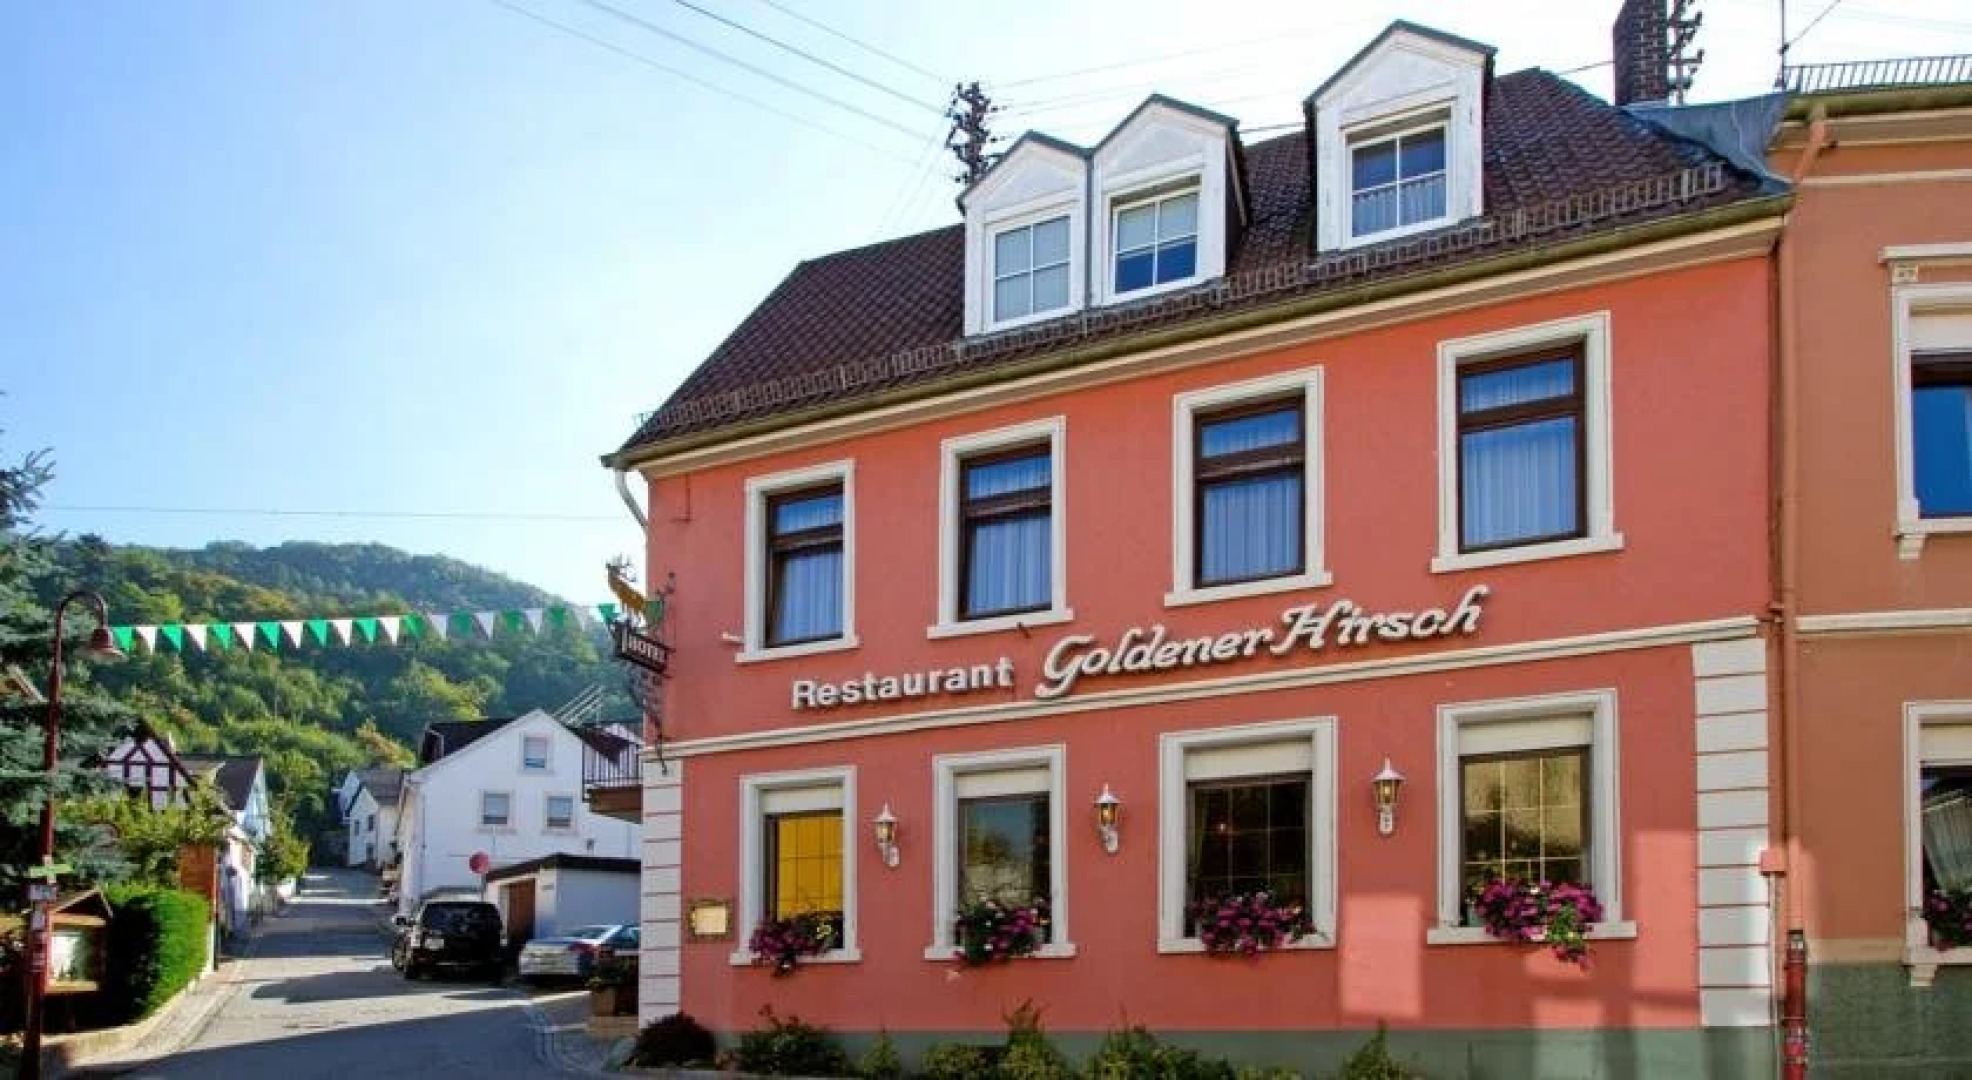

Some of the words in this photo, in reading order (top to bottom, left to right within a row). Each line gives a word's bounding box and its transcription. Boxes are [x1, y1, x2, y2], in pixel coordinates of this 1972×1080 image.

[791, 656, 1015, 709] Restaurant
[1035, 625, 1275, 698] Goldener
[1271, 584, 1490, 654] Hirsch
